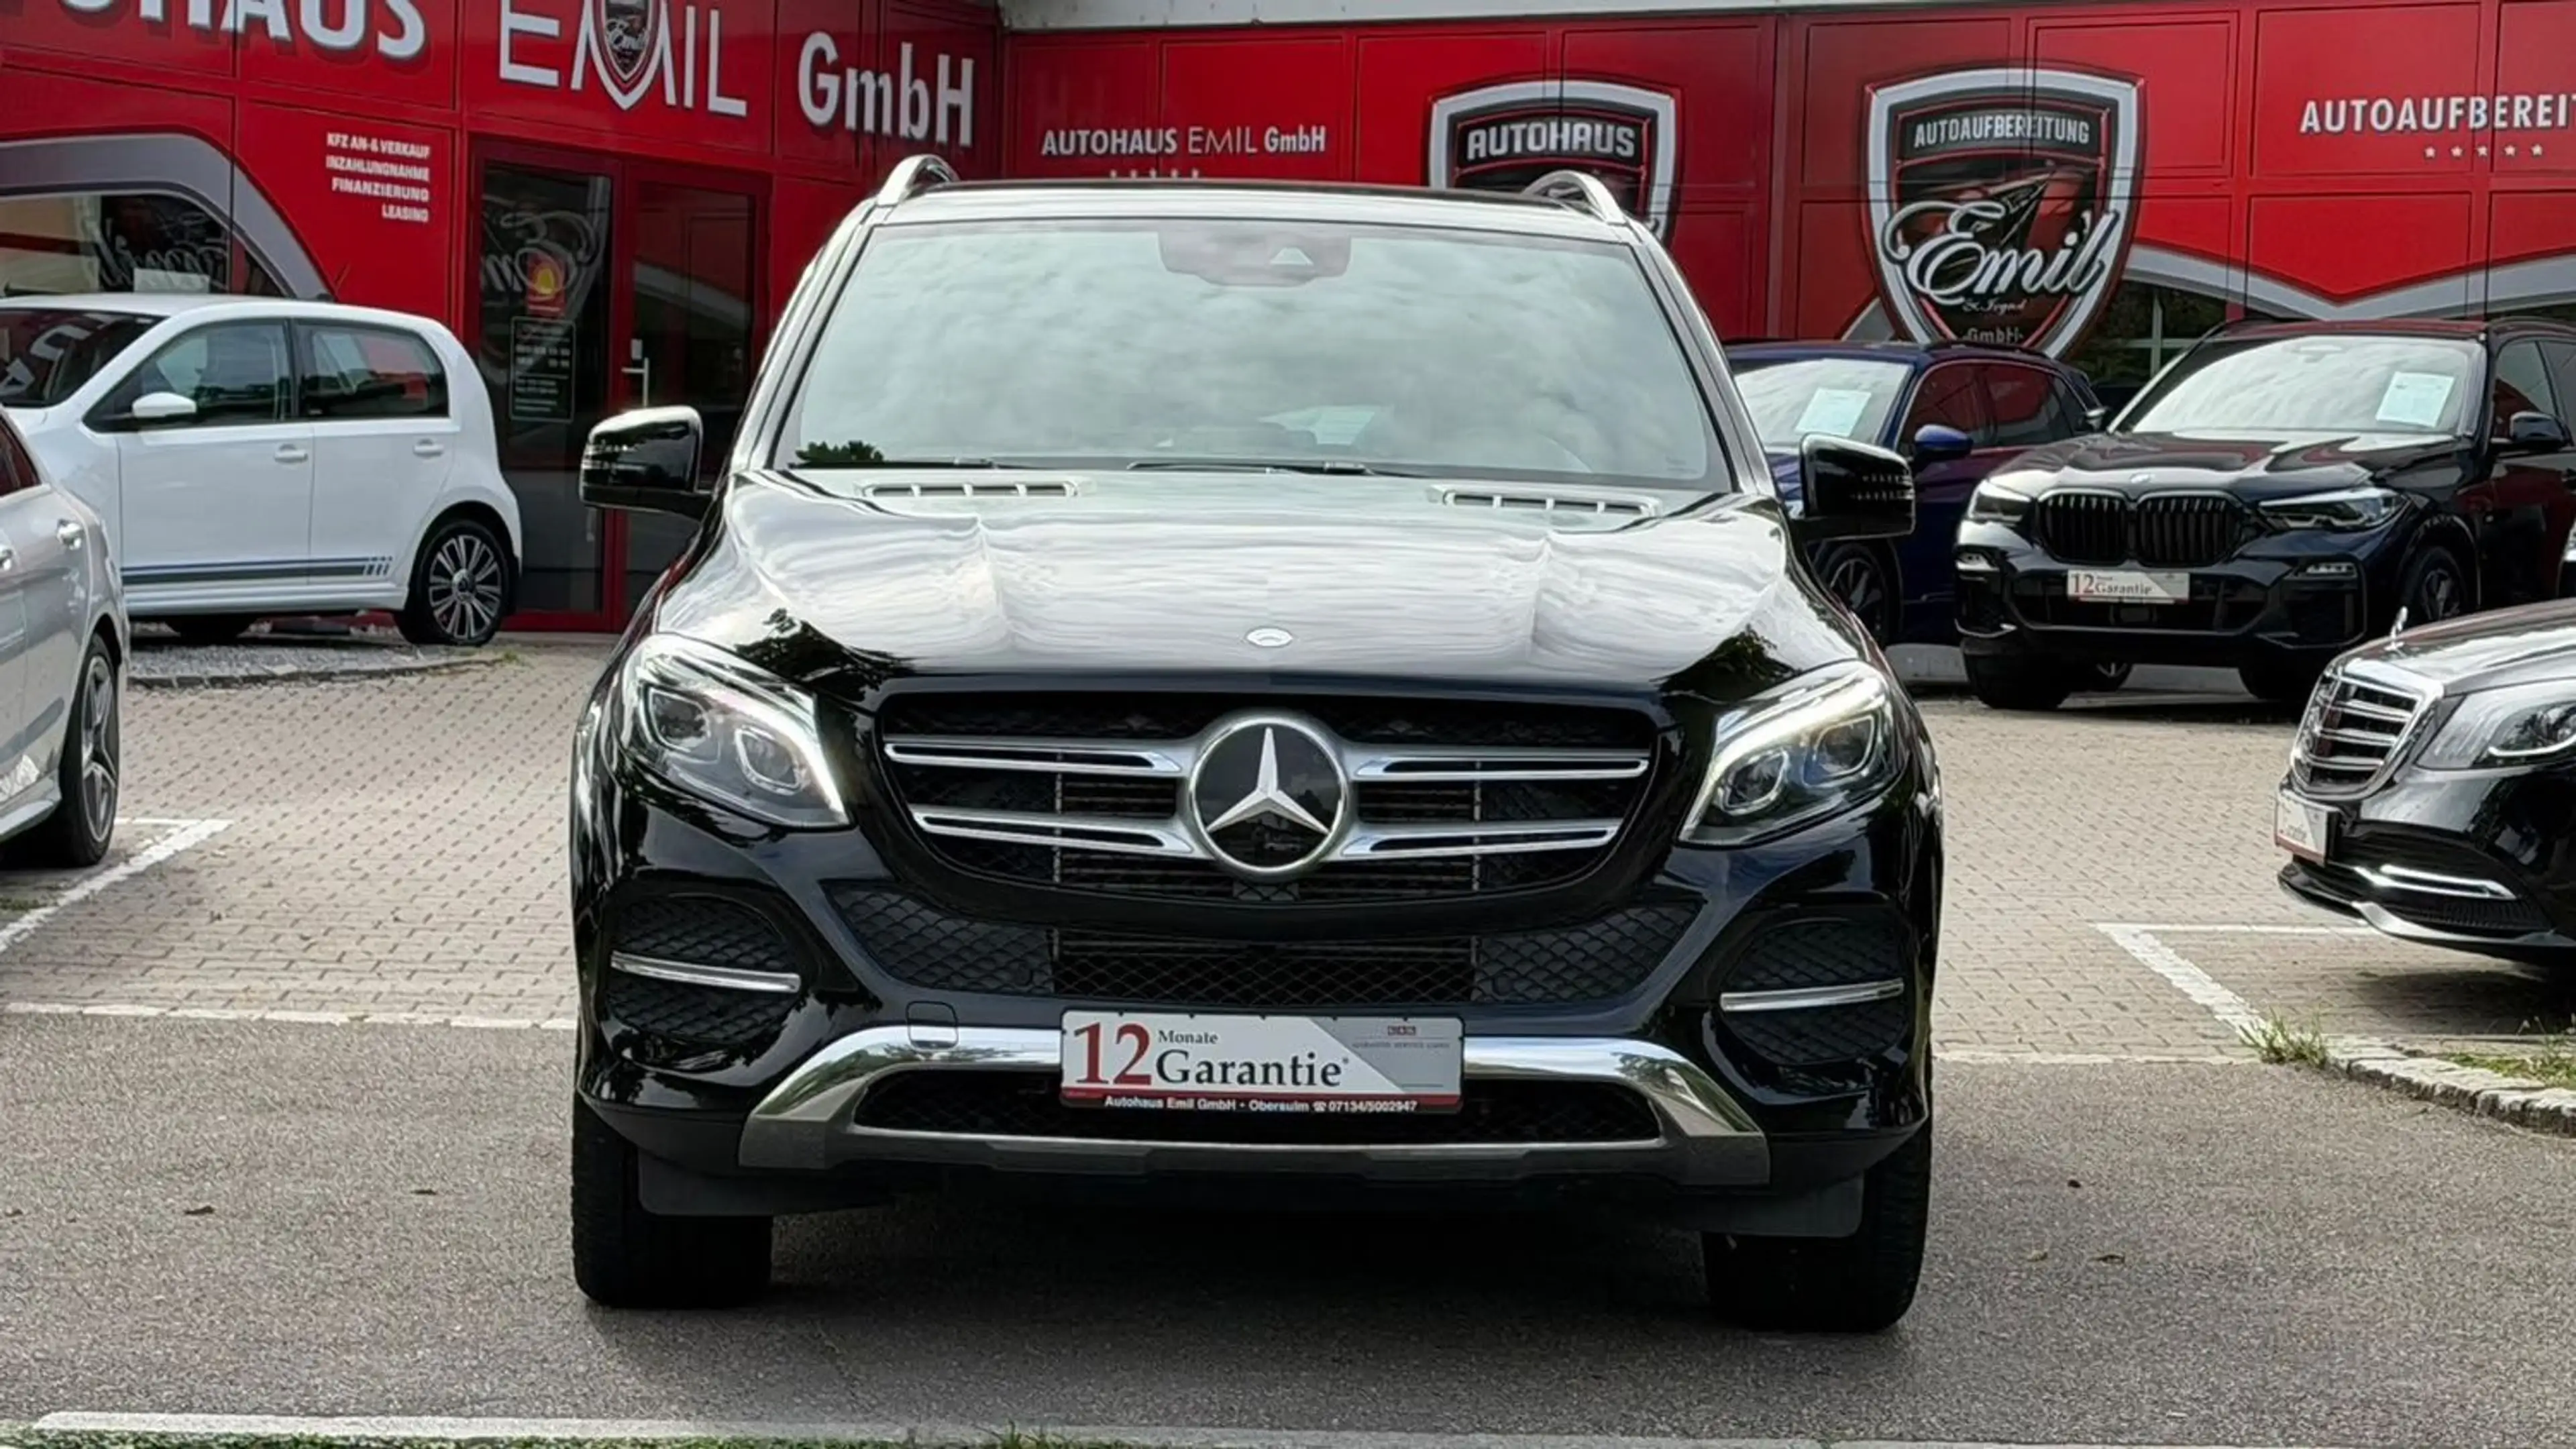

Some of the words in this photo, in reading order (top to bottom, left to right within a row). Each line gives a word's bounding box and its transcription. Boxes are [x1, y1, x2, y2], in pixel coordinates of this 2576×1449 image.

[798, 32, 974, 148] GmbH
[2300, 94, 2576, 133] AUTOAUFBEREI
[327, 132, 349, 148] KFZ
[380, 139, 431, 160] VERKAUF
[1041, 128, 1178, 156] AUTOHAUS
[1187, 126, 1257, 154] EMIL
[1264, 124, 1326, 153] GmbH
[1467, 121, 1635, 161] AUTOHAUS
[1914, 114, 2090, 148] AUTOAUFBEREITUNG
[332, 177, 429, 202] FINANZIERUNG
[382, 203, 429, 223] LEASING
[1883, 201, 2116, 306] Emil
[2072, 573, 2094, 594] 12
[1158, 1029, 1219, 1044] Monate
[1073, 1021, 1152, 1085] 12
[1106, 1095, 1163, 1109] Autohaus
[1167, 1097, 1195, 1110] Emil
[1197, 1097, 1236, 1111] GmbH
[1248, 1099, 1309, 1113] Obersulm
